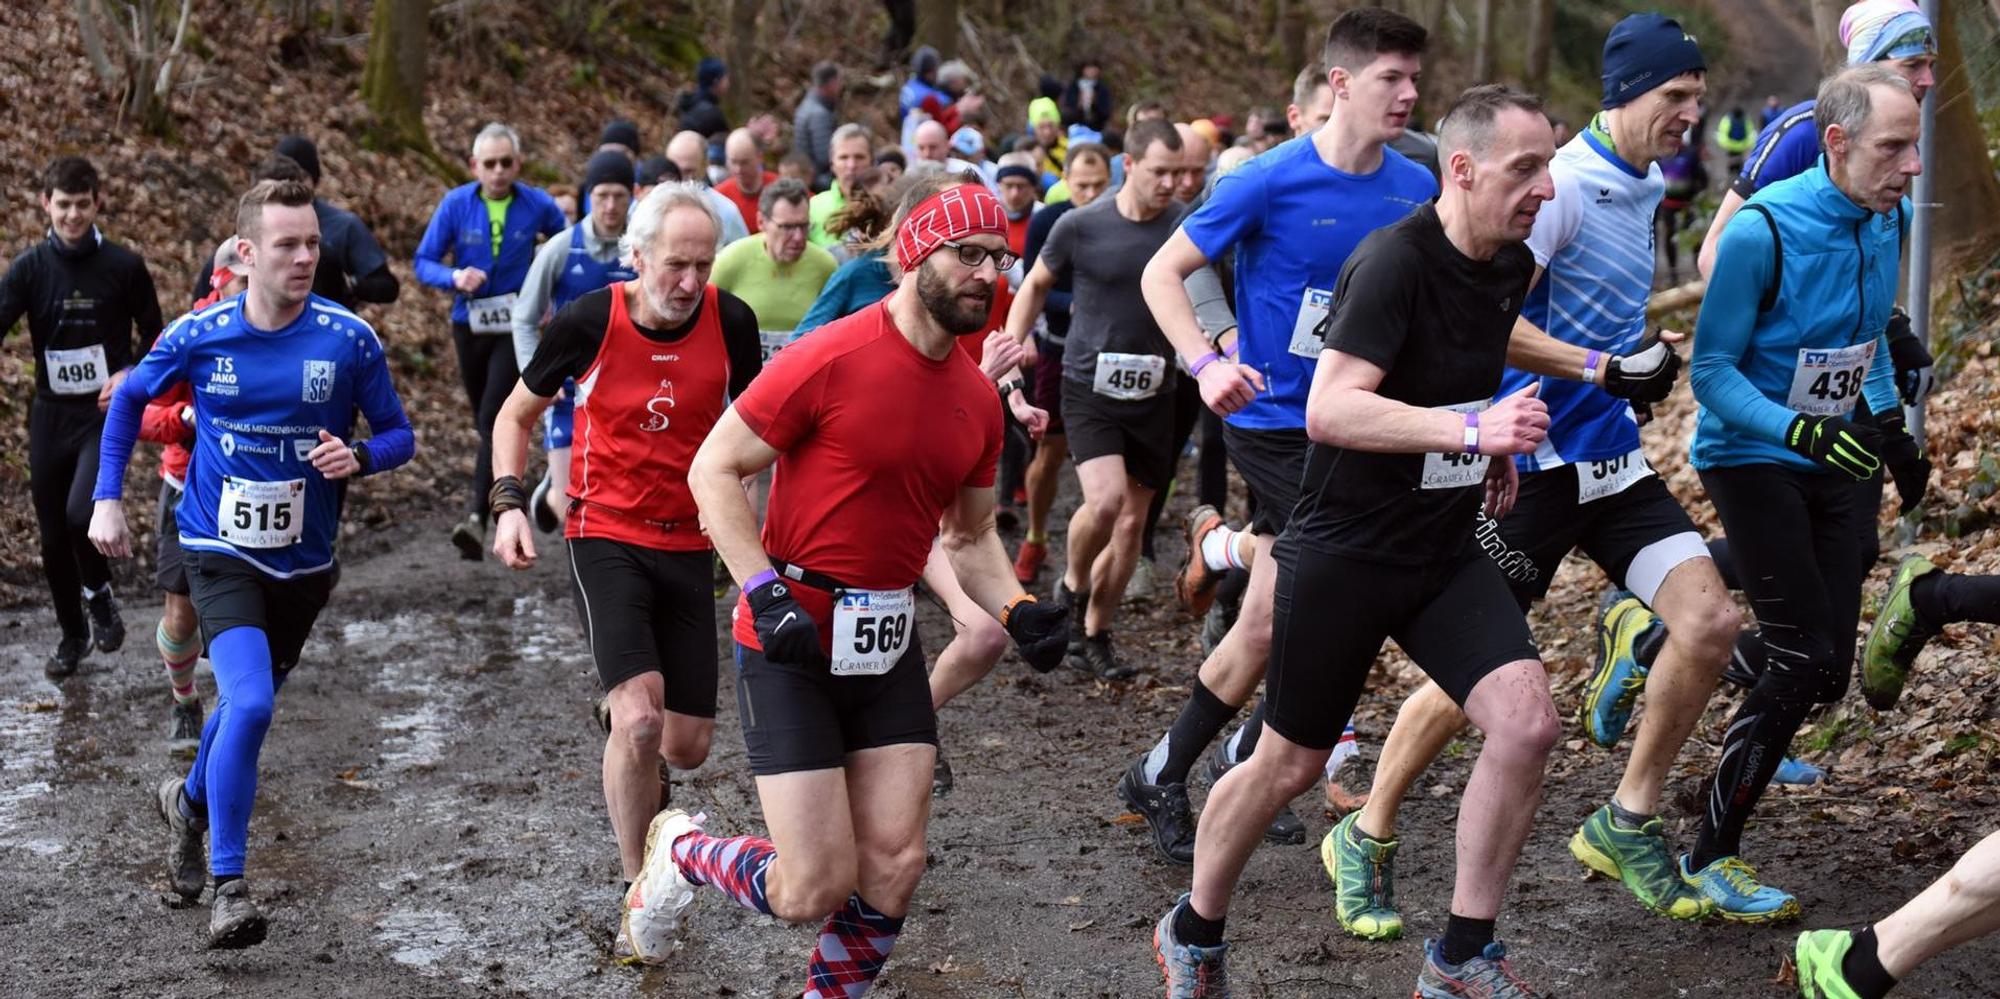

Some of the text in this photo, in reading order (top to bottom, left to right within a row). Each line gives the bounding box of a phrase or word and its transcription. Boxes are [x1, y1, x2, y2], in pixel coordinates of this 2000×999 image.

[480, 308, 511, 326] 443
[57, 361, 97, 384] 498
[215, 356, 234, 373] TS
[211, 371, 238, 385] JAKO
[1108, 368, 1152, 391] 456
[1808, 365, 1865, 401] 438
[237, 443, 279, 455] RENAULT
[234, 500, 291, 531] 515
[853, 613, 907, 655] 569
[838, 658, 881, 673] CRAMER
[1742, 740, 1767, 786] CHAMPION
